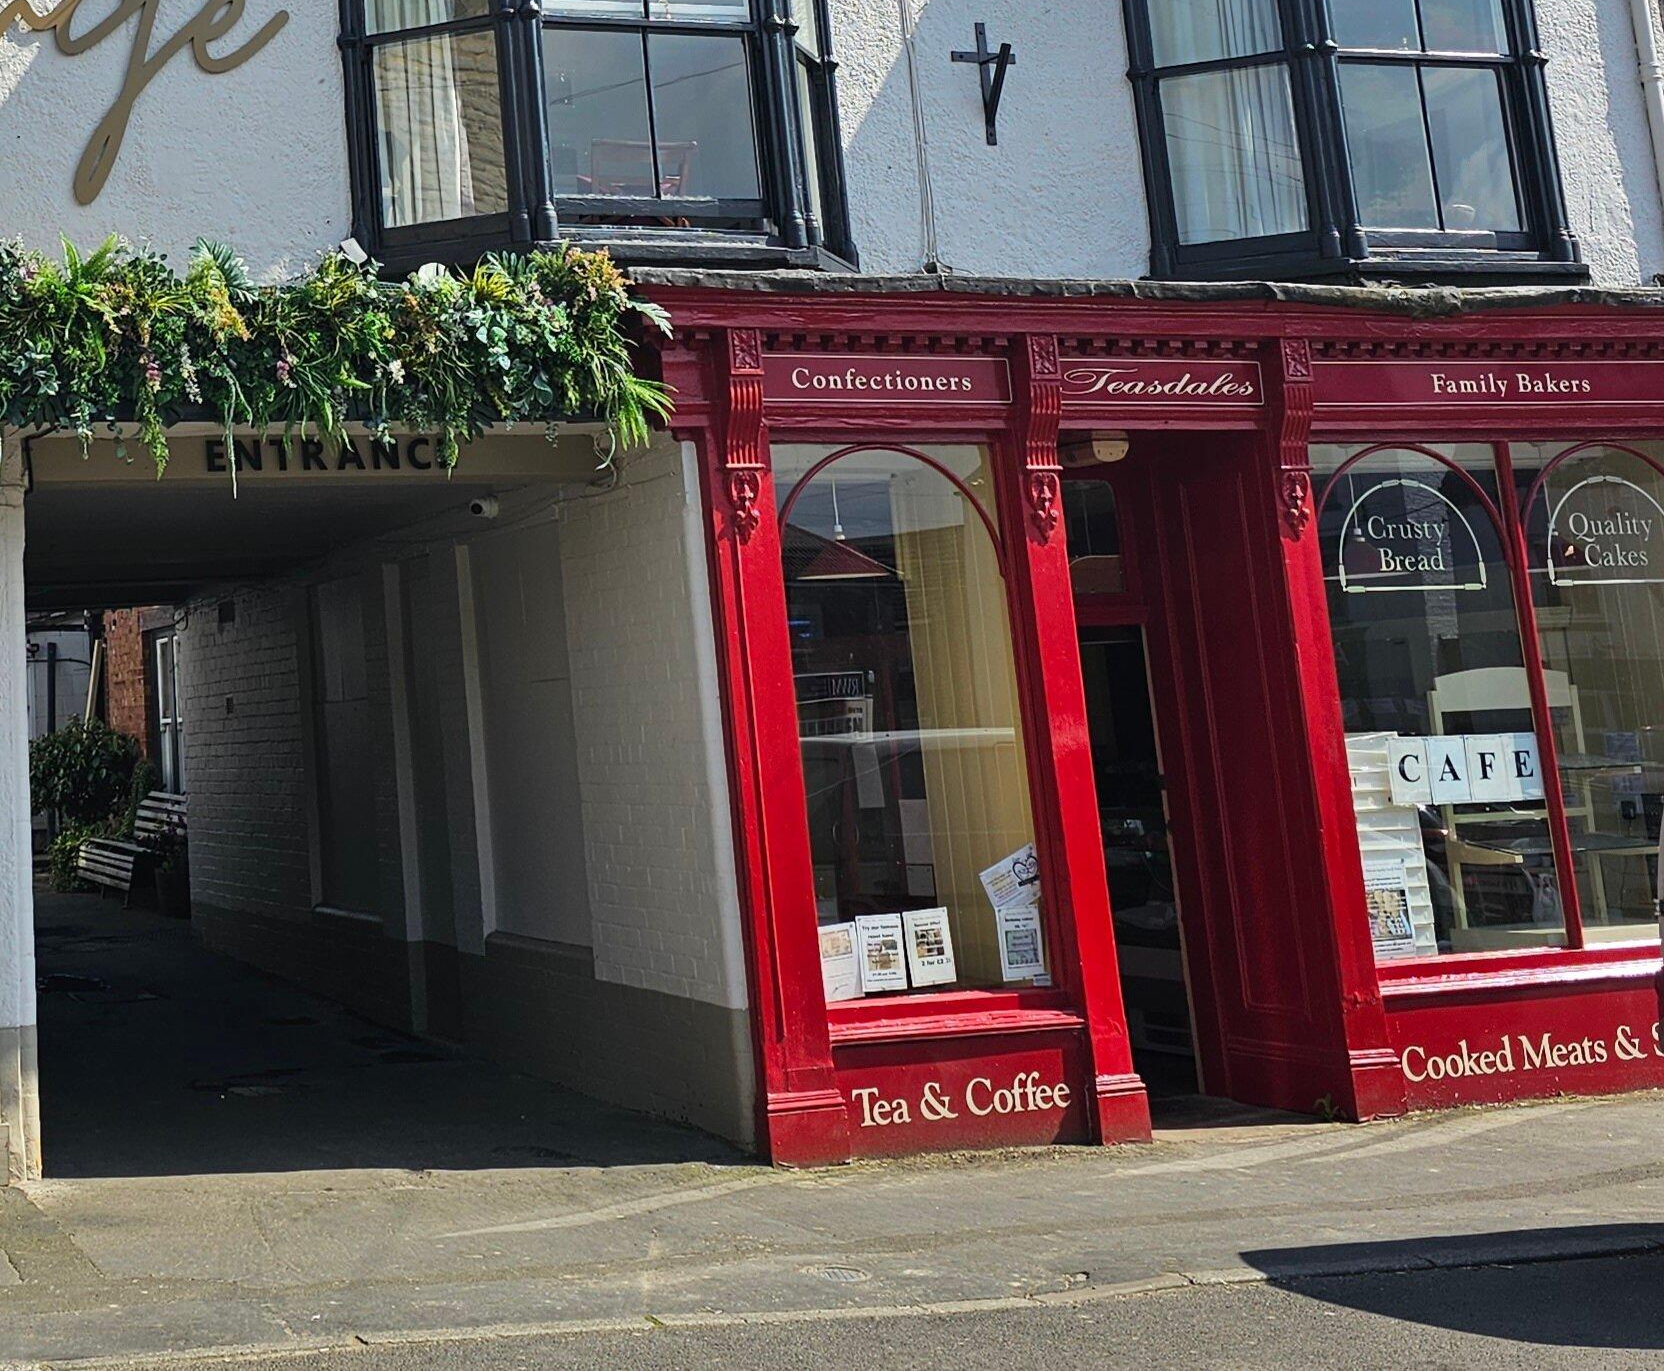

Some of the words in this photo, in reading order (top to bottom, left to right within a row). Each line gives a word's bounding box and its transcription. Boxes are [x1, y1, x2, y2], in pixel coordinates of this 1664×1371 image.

[791, 366, 972, 392] Confectioners
[1060, 367, 1255, 396] Teasdales
[1431, 372, 1508, 399] Family
[1515, 372, 1592, 395] Bakers
[1366, 514, 1446, 548] Crusty
[1568, 511, 1653, 543] Quality
[1379, 547, 1446, 573] Bread
[1584, 542, 1649, 568] Cakes
[1402, 1034, 1515, 1082] Cooked
[1518, 1032, 1608, 1071] Meats
[1614, 1025, 1648, 1061] &
[852, 1087, 912, 1127] Tea
[919, 1081, 959, 1121] &
[965, 1070, 1071, 1116] Coffee
